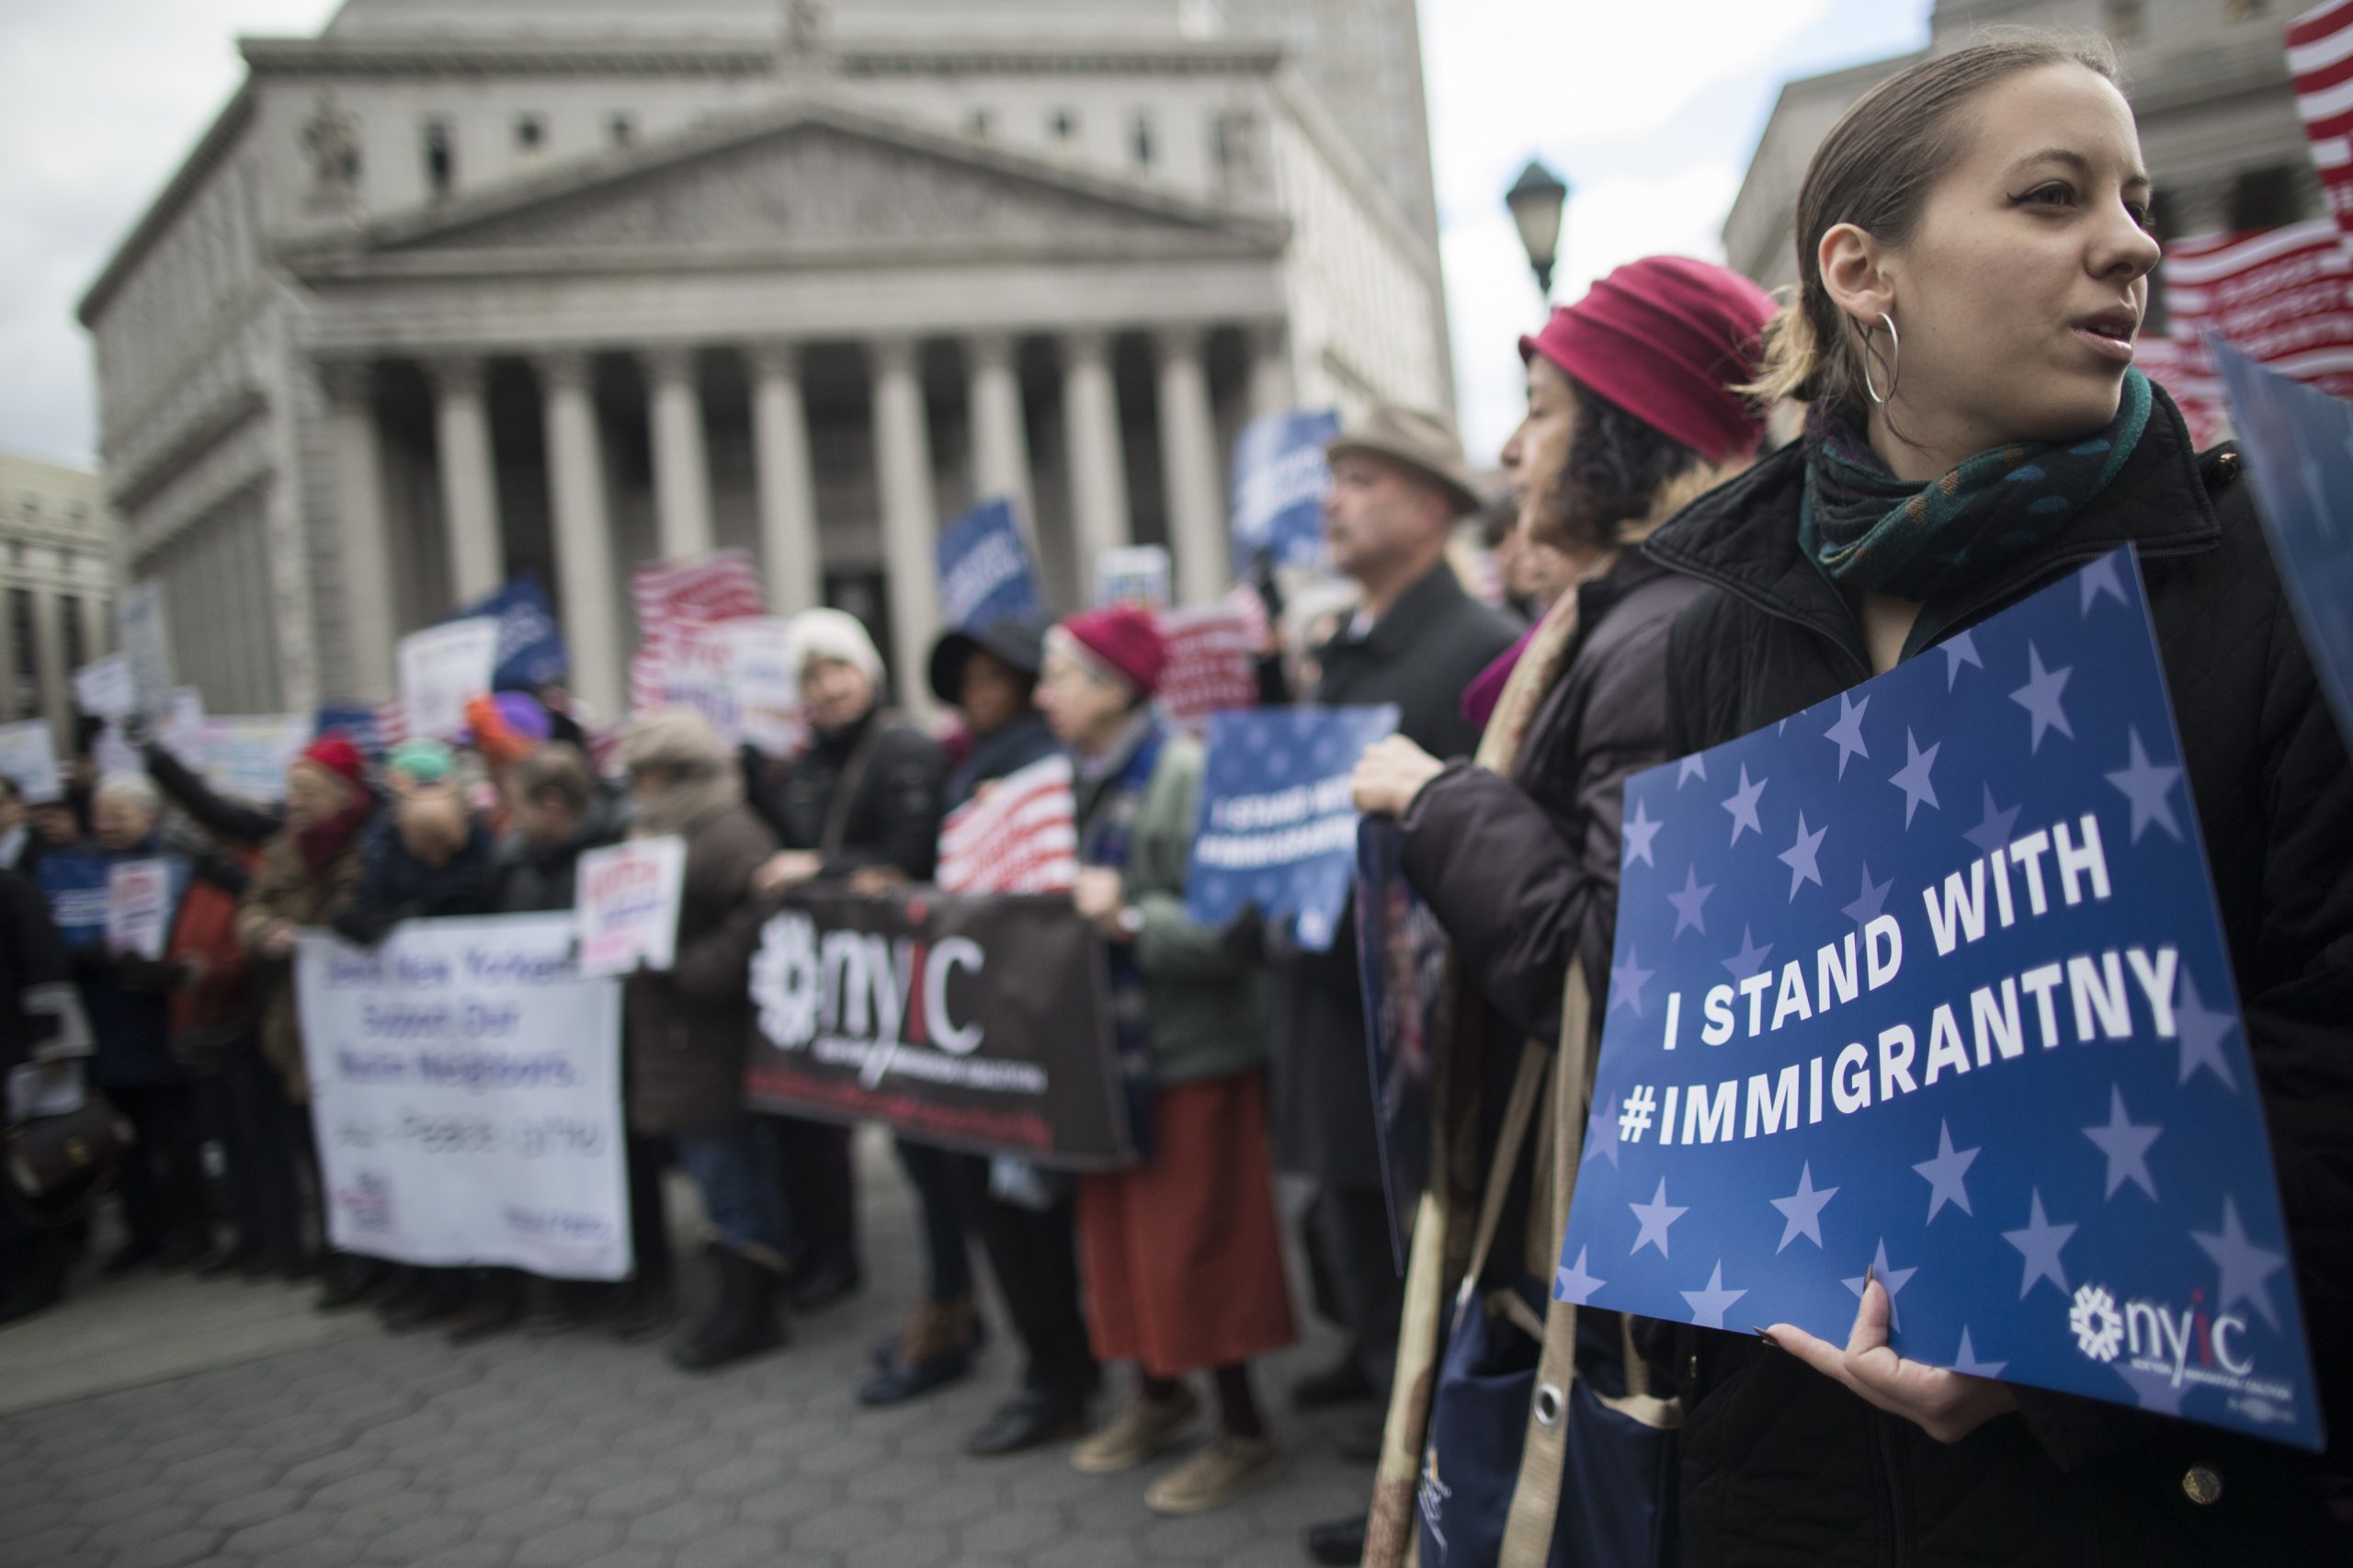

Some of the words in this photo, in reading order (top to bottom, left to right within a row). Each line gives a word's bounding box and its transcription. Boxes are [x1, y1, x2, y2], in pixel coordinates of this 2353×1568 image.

[821, 896, 984, 1089] nyic
[1664, 993, 1680, 1050] I
[1700, 914, 1903, 1048] STAND
[1923, 814, 2111, 959] WITH
[1619, 947, 2178, 1145] #IMMIGRANTNY
[2125, 1287, 2247, 1388] nyic
